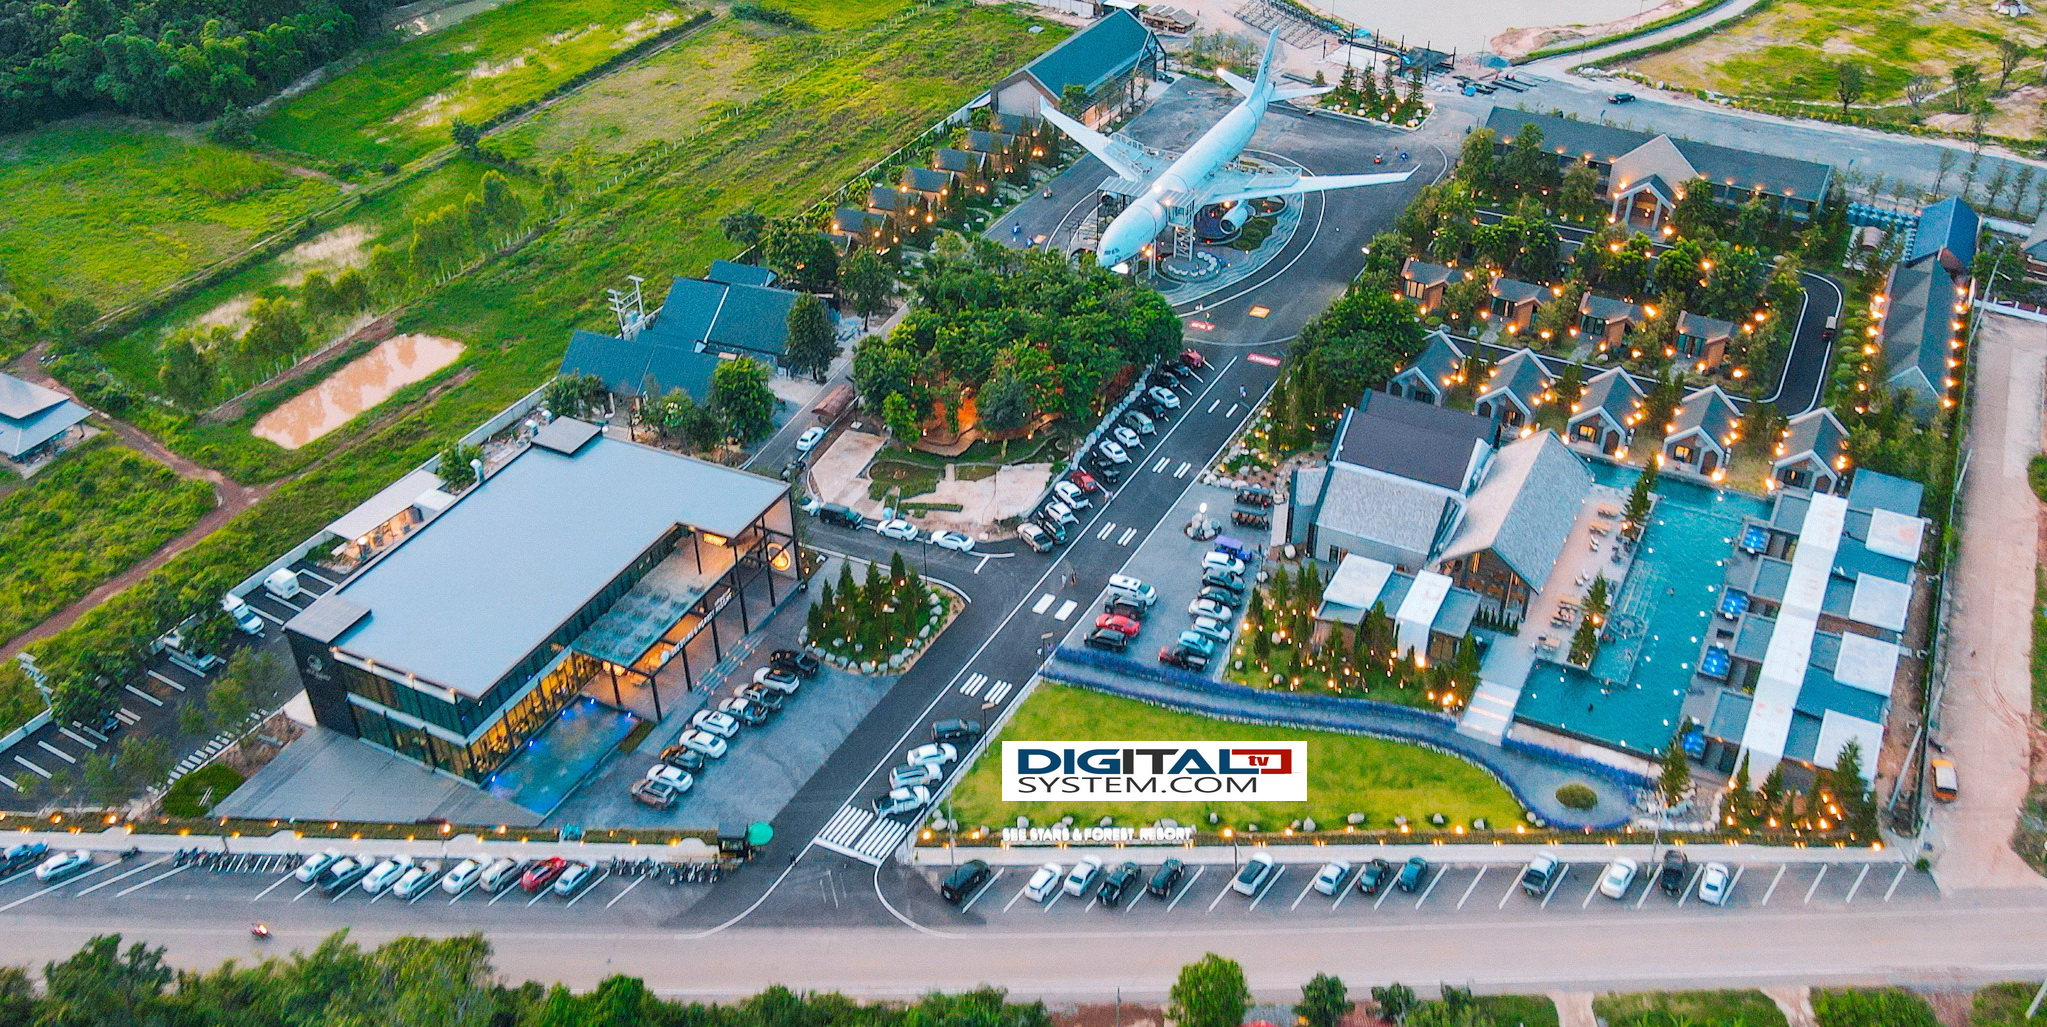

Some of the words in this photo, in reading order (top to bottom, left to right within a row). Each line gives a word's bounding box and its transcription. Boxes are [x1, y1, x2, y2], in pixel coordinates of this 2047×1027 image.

[1030, 827, 1070, 842] STARS
[1072, 828, 1083, 842] &
[1084, 827, 1135, 842] FOREST
[1139, 827, 1192, 842] RESORT
